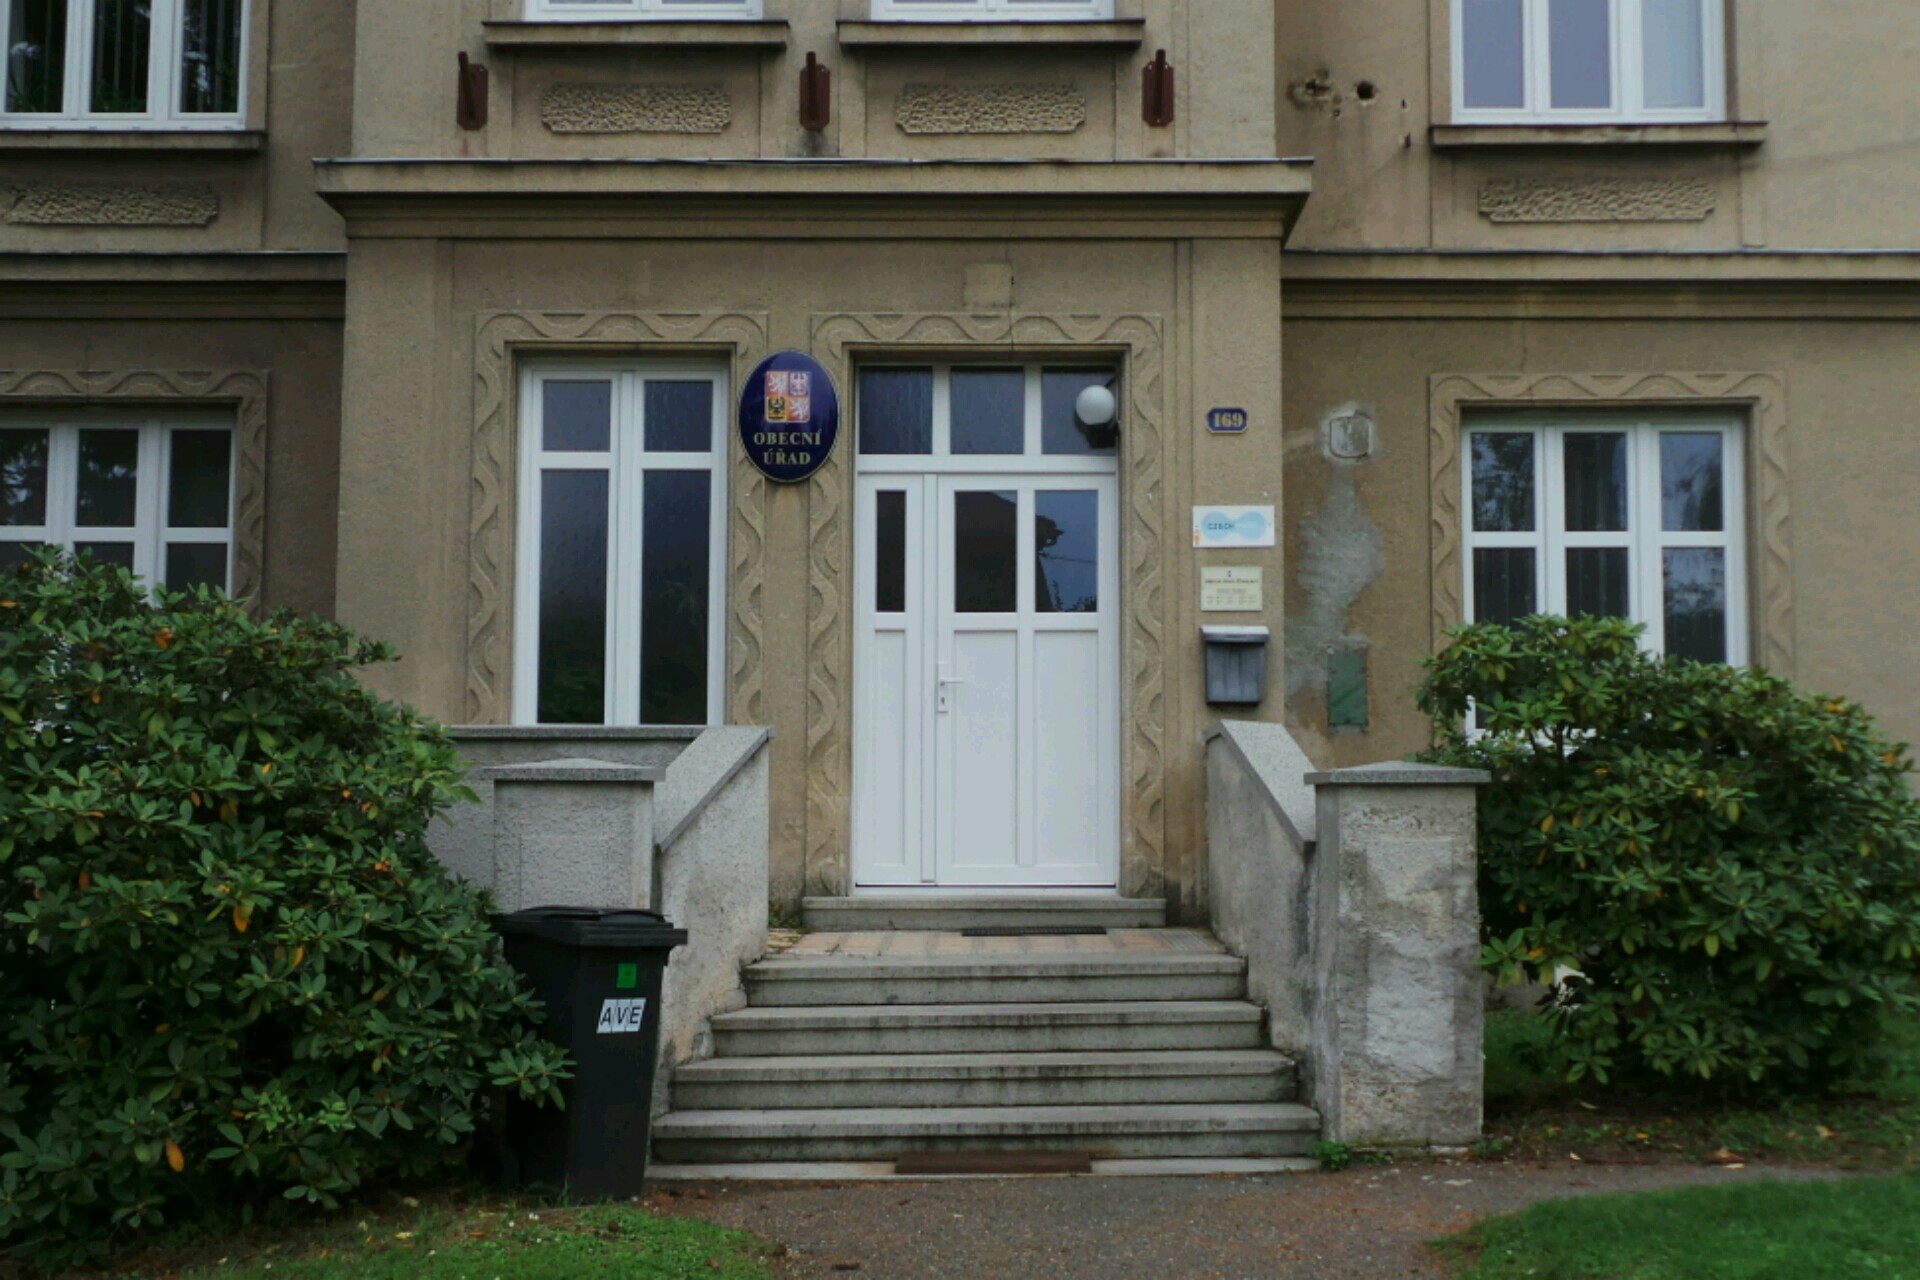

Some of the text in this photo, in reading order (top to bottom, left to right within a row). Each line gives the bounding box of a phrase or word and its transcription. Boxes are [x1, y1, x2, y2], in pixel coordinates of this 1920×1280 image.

[1214, 412, 1243, 427] 169
[753, 429, 821, 445] OBECNÍ
[764, 448, 811, 465] ÚŘAD
[1207, 522, 1235, 531] CZECH
[601, 1008, 641, 1025] AVE
